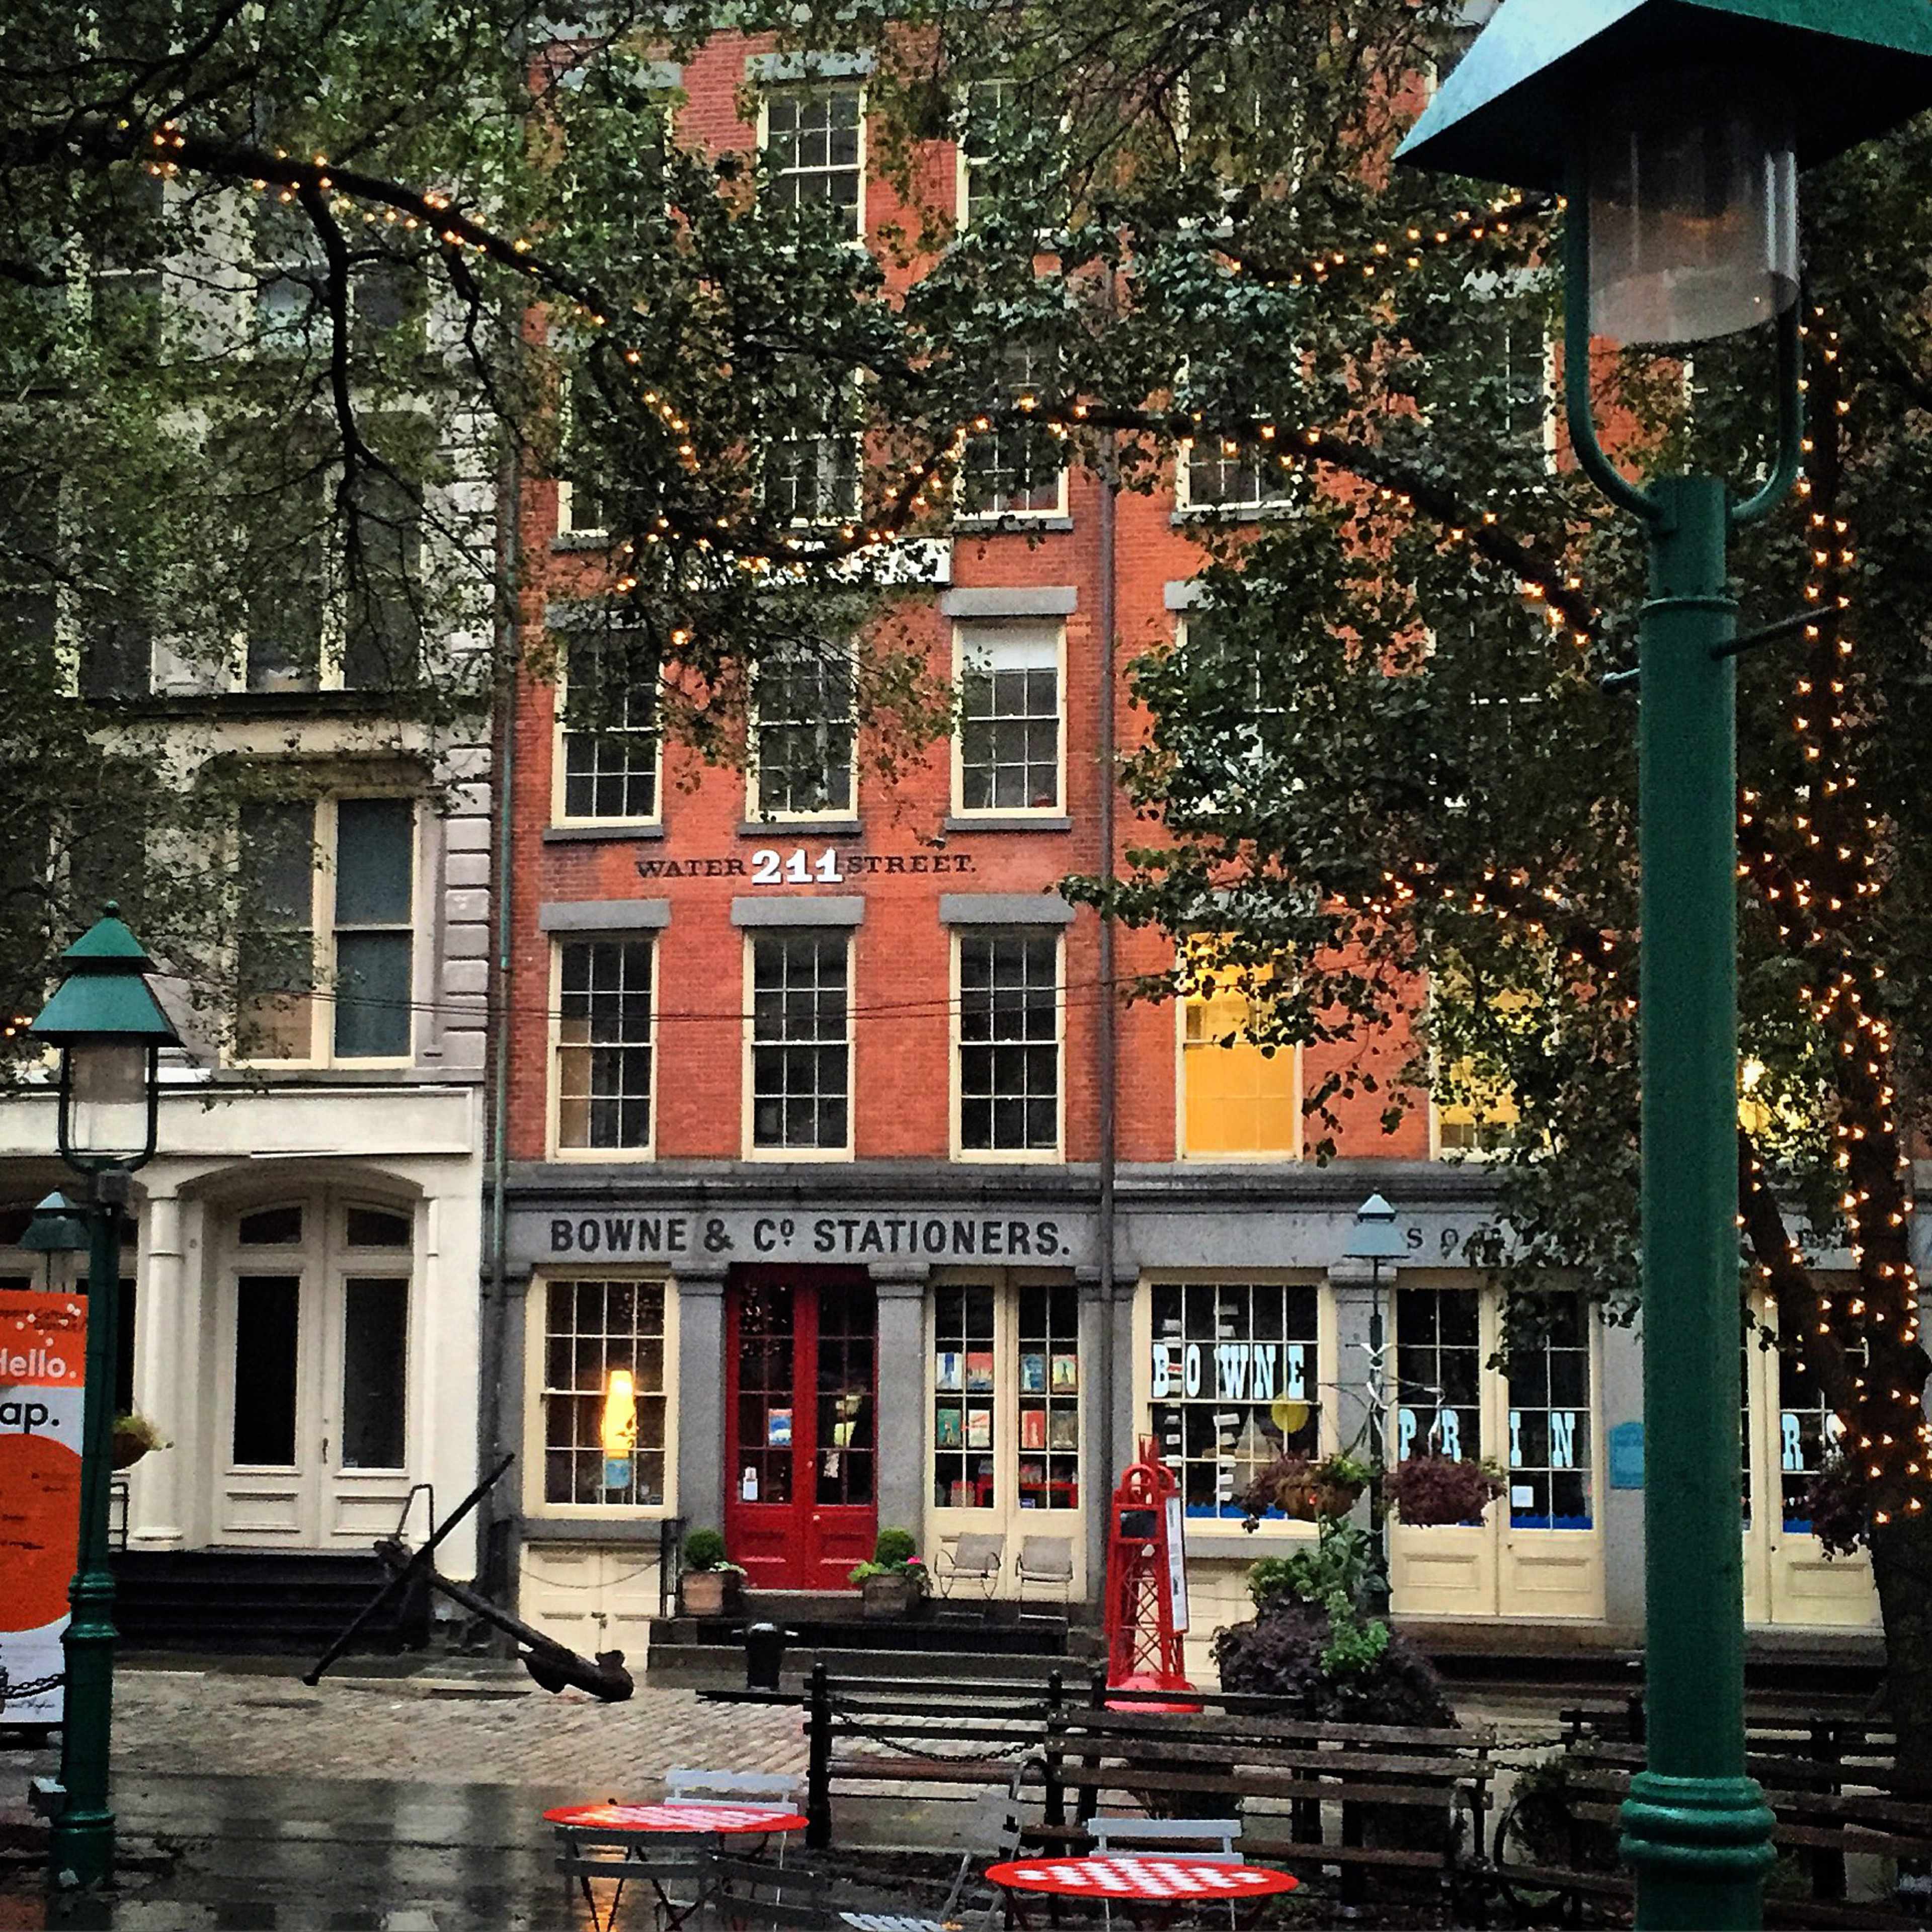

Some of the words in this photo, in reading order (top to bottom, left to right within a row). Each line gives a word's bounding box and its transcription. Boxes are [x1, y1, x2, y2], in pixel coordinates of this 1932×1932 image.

[636, 858, 748, 878] WATER
[751, 848, 846, 884] 211
[846, 854, 978, 875] STREET.
[550, 1218, 687, 1252] BOWNE
[704, 1218, 735, 1253] &
[814, 1219, 1071, 1256] STATIONERS.
[1153, 1343, 1305, 1399] BOWNE
